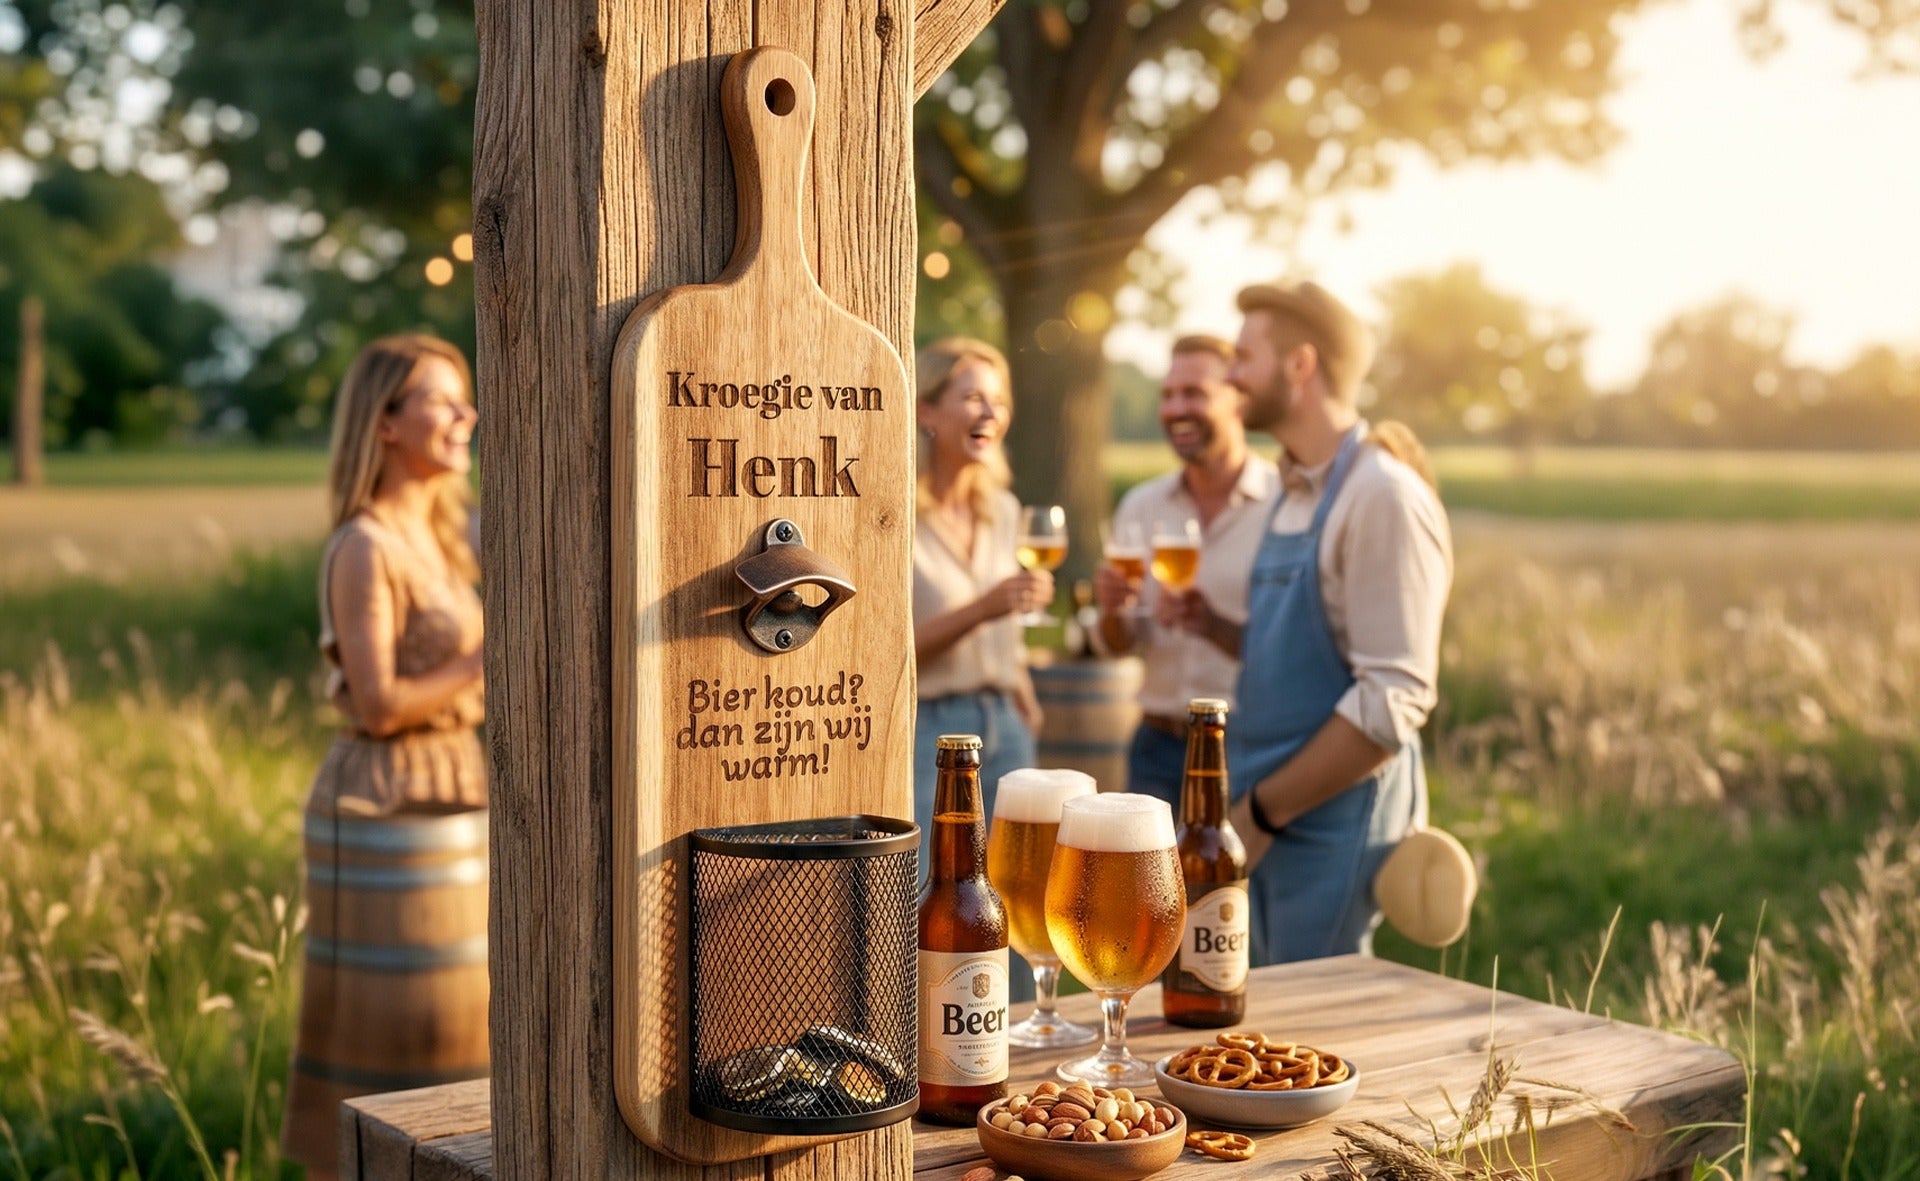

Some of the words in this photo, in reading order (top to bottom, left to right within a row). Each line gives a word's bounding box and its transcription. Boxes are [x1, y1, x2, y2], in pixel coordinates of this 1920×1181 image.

[667, 371, 813, 420] Kroegie
[820, 384, 884, 411] van
[687, 435, 861, 498] Henk
[688, 678, 757, 714] Bier
[764, 670, 864, 709] koud?
[676, 713, 744, 750] dan
[754, 710, 815, 754] zijn
[823, 704, 872, 751] wij
[721, 743, 830, 781] warm!
[1194, 926, 1246, 954] Beer
[942, 1003, 1006, 1036] Beer
